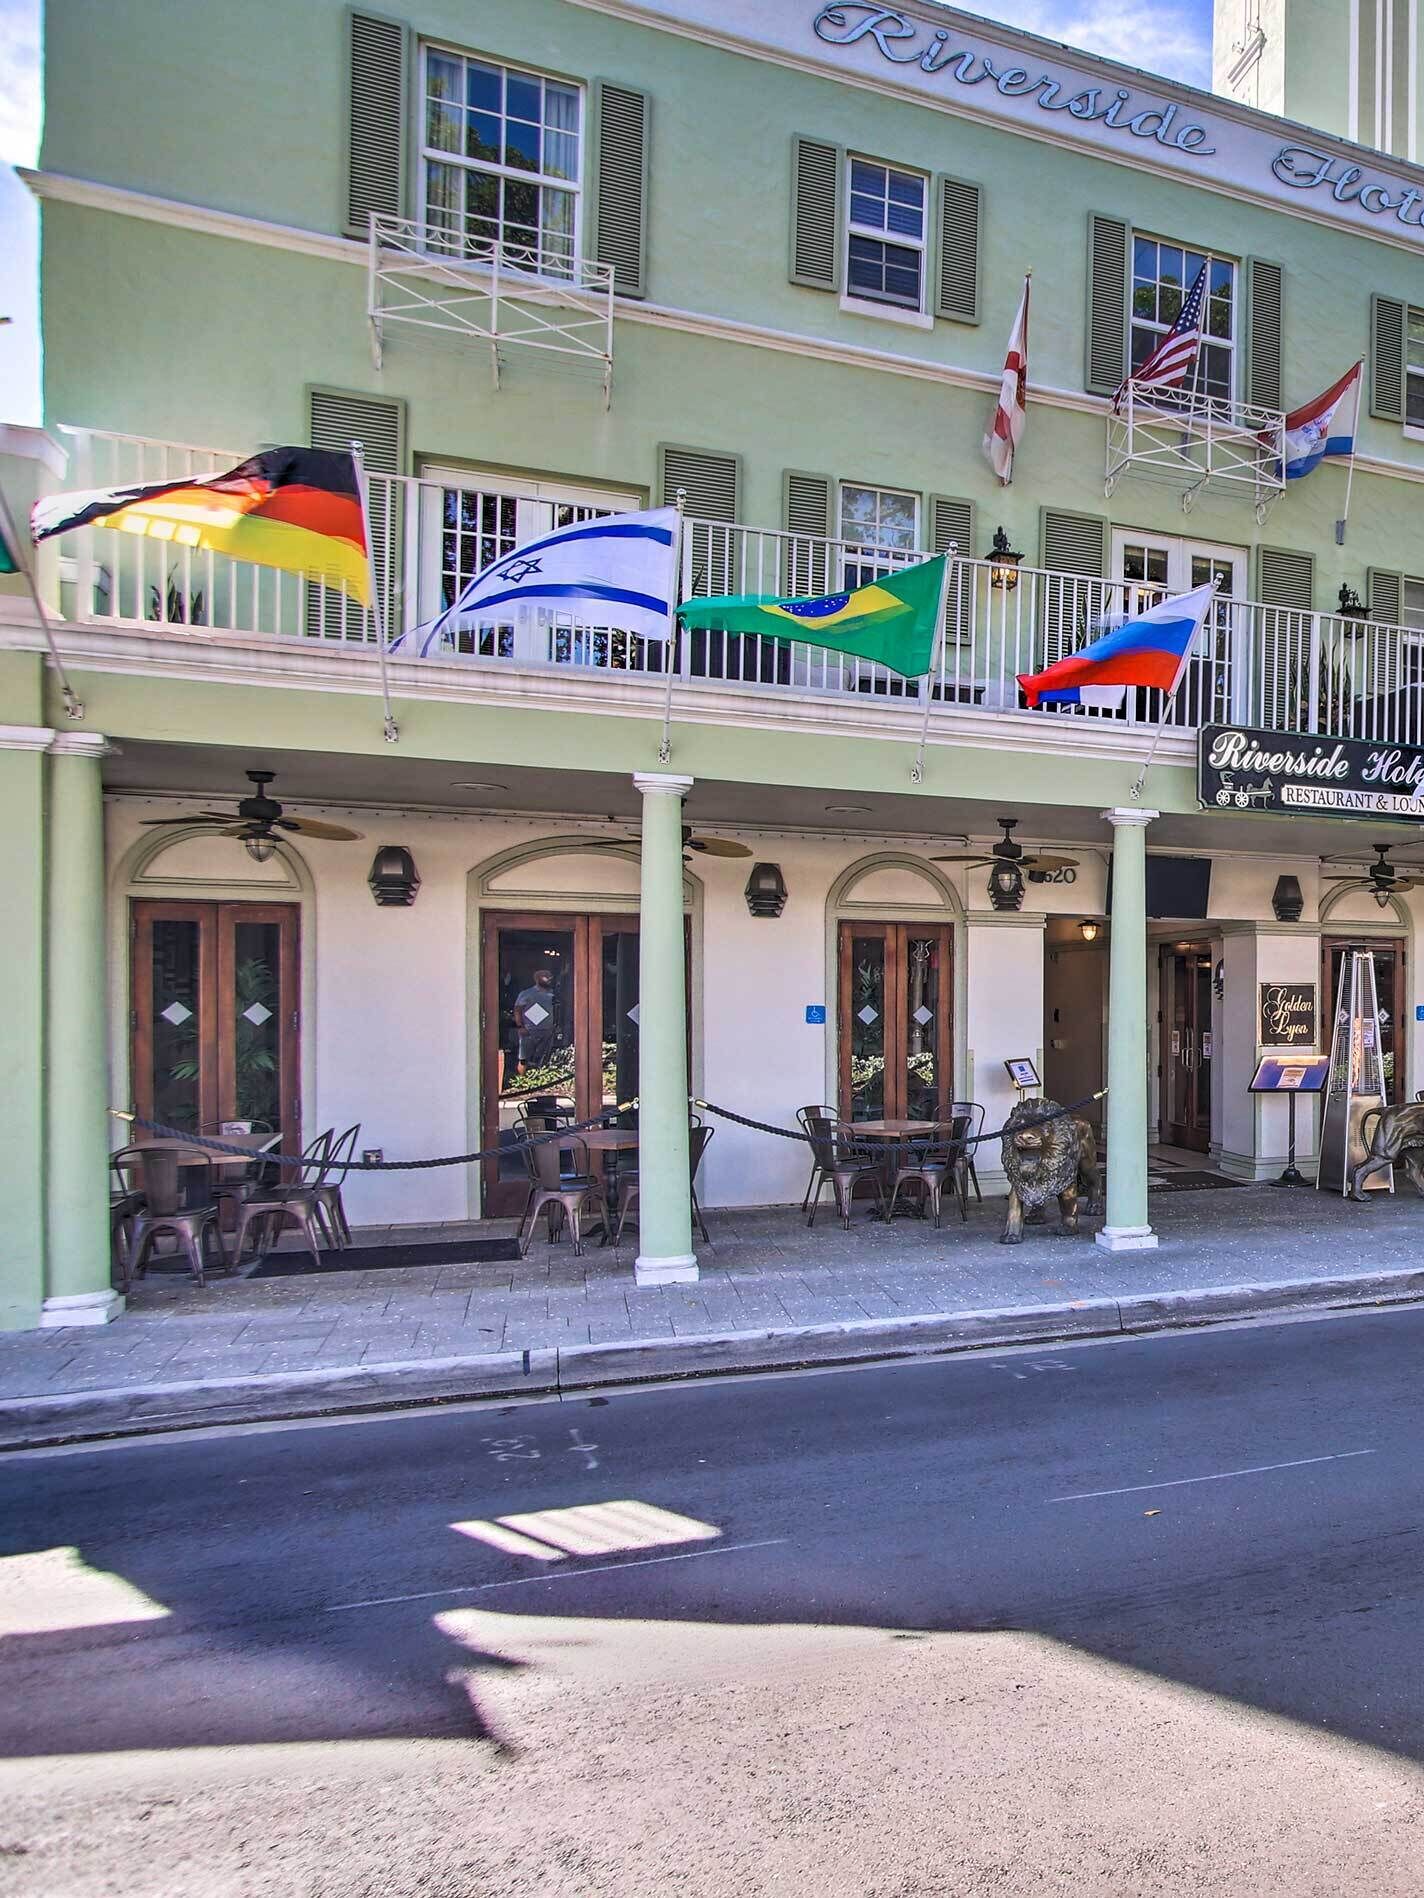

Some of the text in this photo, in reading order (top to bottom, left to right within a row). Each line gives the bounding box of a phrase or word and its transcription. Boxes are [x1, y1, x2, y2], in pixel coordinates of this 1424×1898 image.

[814, 1, 1216, 155] Riverside
[1209, 731, 1349, 779] Riverside
[1286, 786, 1373, 810] RESTAURANT
[1376, 795, 1388, 811] &
[1263, 987, 1313, 1020] Golden
[1269, 1011, 1309, 1042] Lyon
